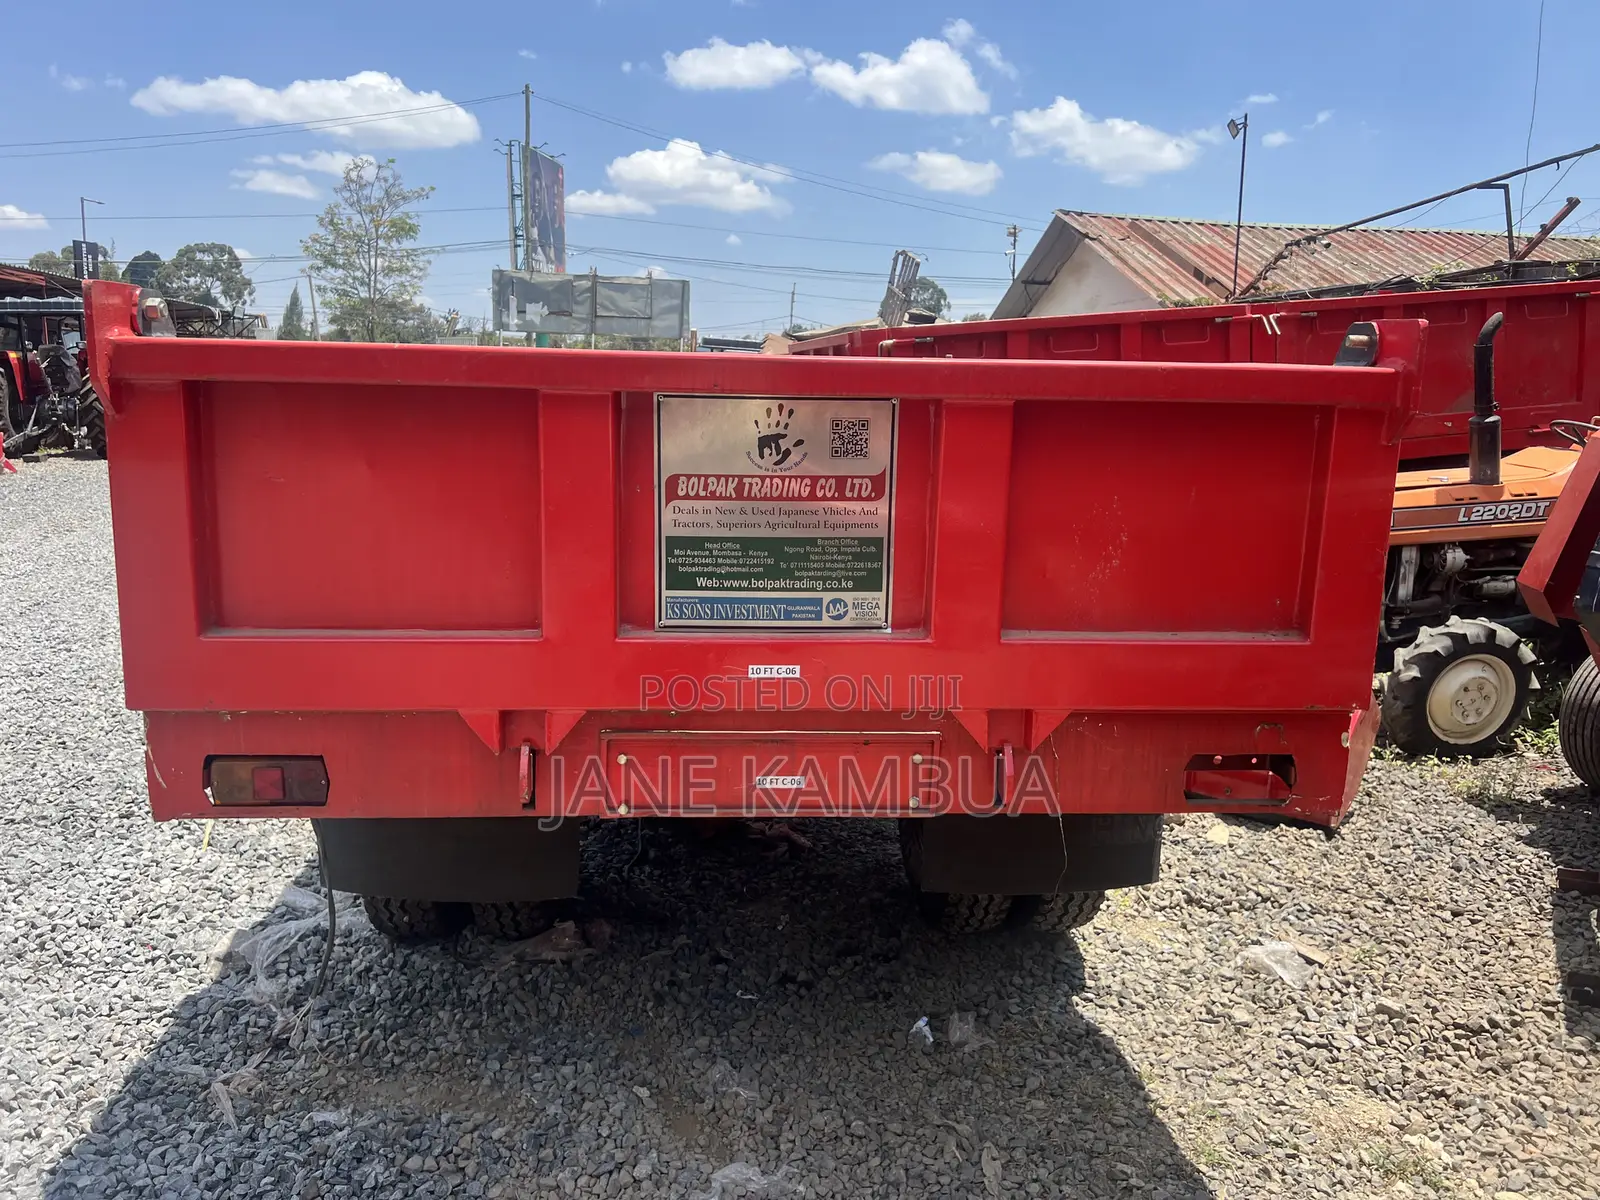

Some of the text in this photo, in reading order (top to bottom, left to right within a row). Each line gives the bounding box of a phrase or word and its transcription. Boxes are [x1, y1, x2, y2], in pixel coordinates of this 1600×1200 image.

[746, 451, 763, 470] Success
[794, 452, 808, 468] Hands
[677, 476, 876, 498] BOLPAK TRADING CO. LTD.
[672, 505, 878, 518] Deals in New & Used Japanese Vhicles And
[1457, 502, 1550, 522] L2202DT
[672, 519, 878, 531] Tractors, Superiors Agricultural Equipments
[678, 566, 764, 574] bolpaktrading@hotmail.com
[696, 577, 854, 590] Web:www.bolpaktrading.co.ke
[666, 603, 786, 620] KS SONS INVESTMENT
[852, 602, 880, 610] MEGA
[750, 667, 797, 675] 10 FT C-06
[757, 778, 801, 786] 10 FT C-06
